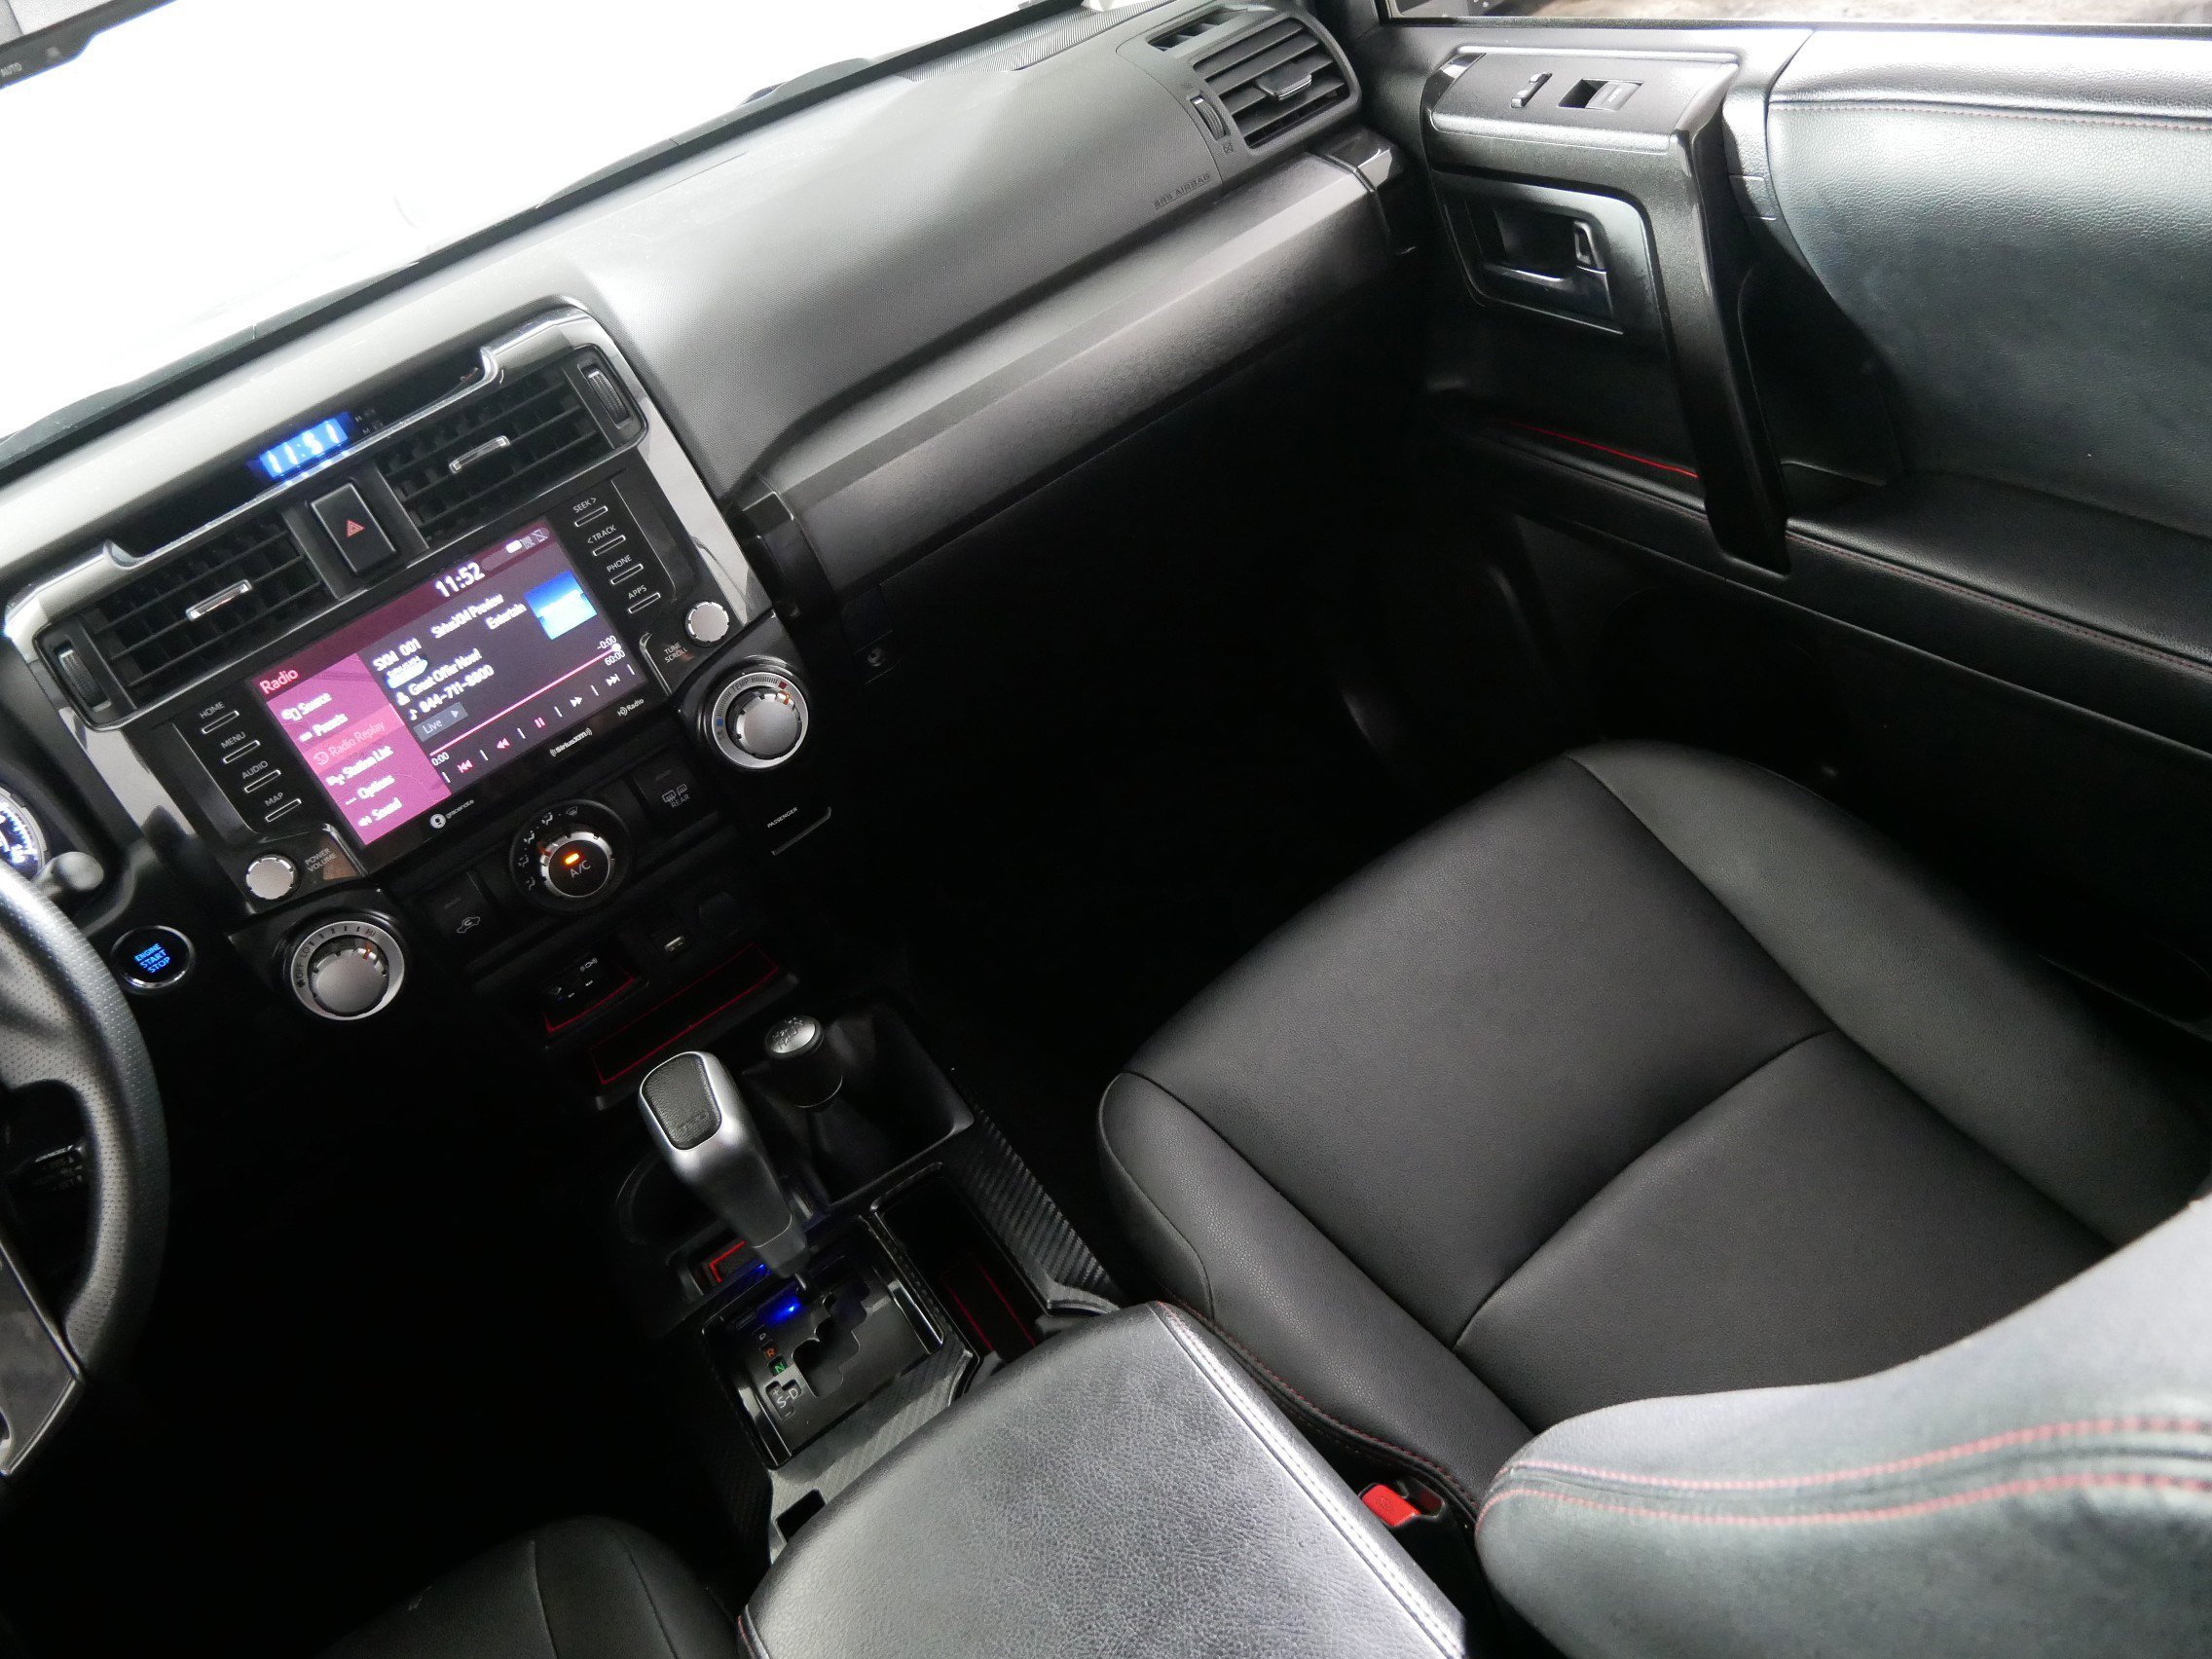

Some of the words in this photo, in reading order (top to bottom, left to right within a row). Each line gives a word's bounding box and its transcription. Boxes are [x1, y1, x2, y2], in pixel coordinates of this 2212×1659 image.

[1175, 173, 1210, 196] AIRBAG
[572, 499, 591, 514] SEEK
[592, 525, 616, 542] TRACK
[606, 554, 633, 572] PHONE
[434, 562, 486, 597] 11:52
[628, 584, 647, 600] APPS
[468, 592, 504, 620] Preview
[373, 649, 400, 671] SXM
[398, 638, 423, 659] 001
[663, 642, 682, 655] TUNE
[664, 647, 687, 664] SCROLL
[604, 649, 626, 668] 60:00
[259, 668, 299, 694] Radio
[409, 674, 438, 697] Great
[731, 679, 750, 693] TEMP
[199, 701, 225, 719] HOME
[297, 692, 332, 717] Source
[626, 698, 645, 713] Radio
[313, 713, 349, 737] Presets
[422, 718, 442, 735] Live
[220, 731, 246, 750] MENU
[329, 737, 356, 758] Radio
[352, 720, 386, 745] Replay
[343, 756, 374, 779] Station
[371, 745, 394, 765] List
[430, 751, 450, 766] 0:00
[241, 760, 269, 779] AUDIO
[357, 775, 395, 800] Options
[264, 792, 284, 807] MAP
[371, 796, 403, 821] Sound
[670, 792, 690, 809] REAR
[445, 799, 475, 820] gracenote
[766, 806, 799, 830] PASSENGER
[304, 847, 331, 866] POWER
[307, 852, 338, 872] VOLUME
[569, 858, 591, 879] A/C
[133, 942, 162, 962] ENGINE
[140, 948, 167, 968] START
[147, 956, 171, 974] STOP
[775, 1363, 786, 1374] N
